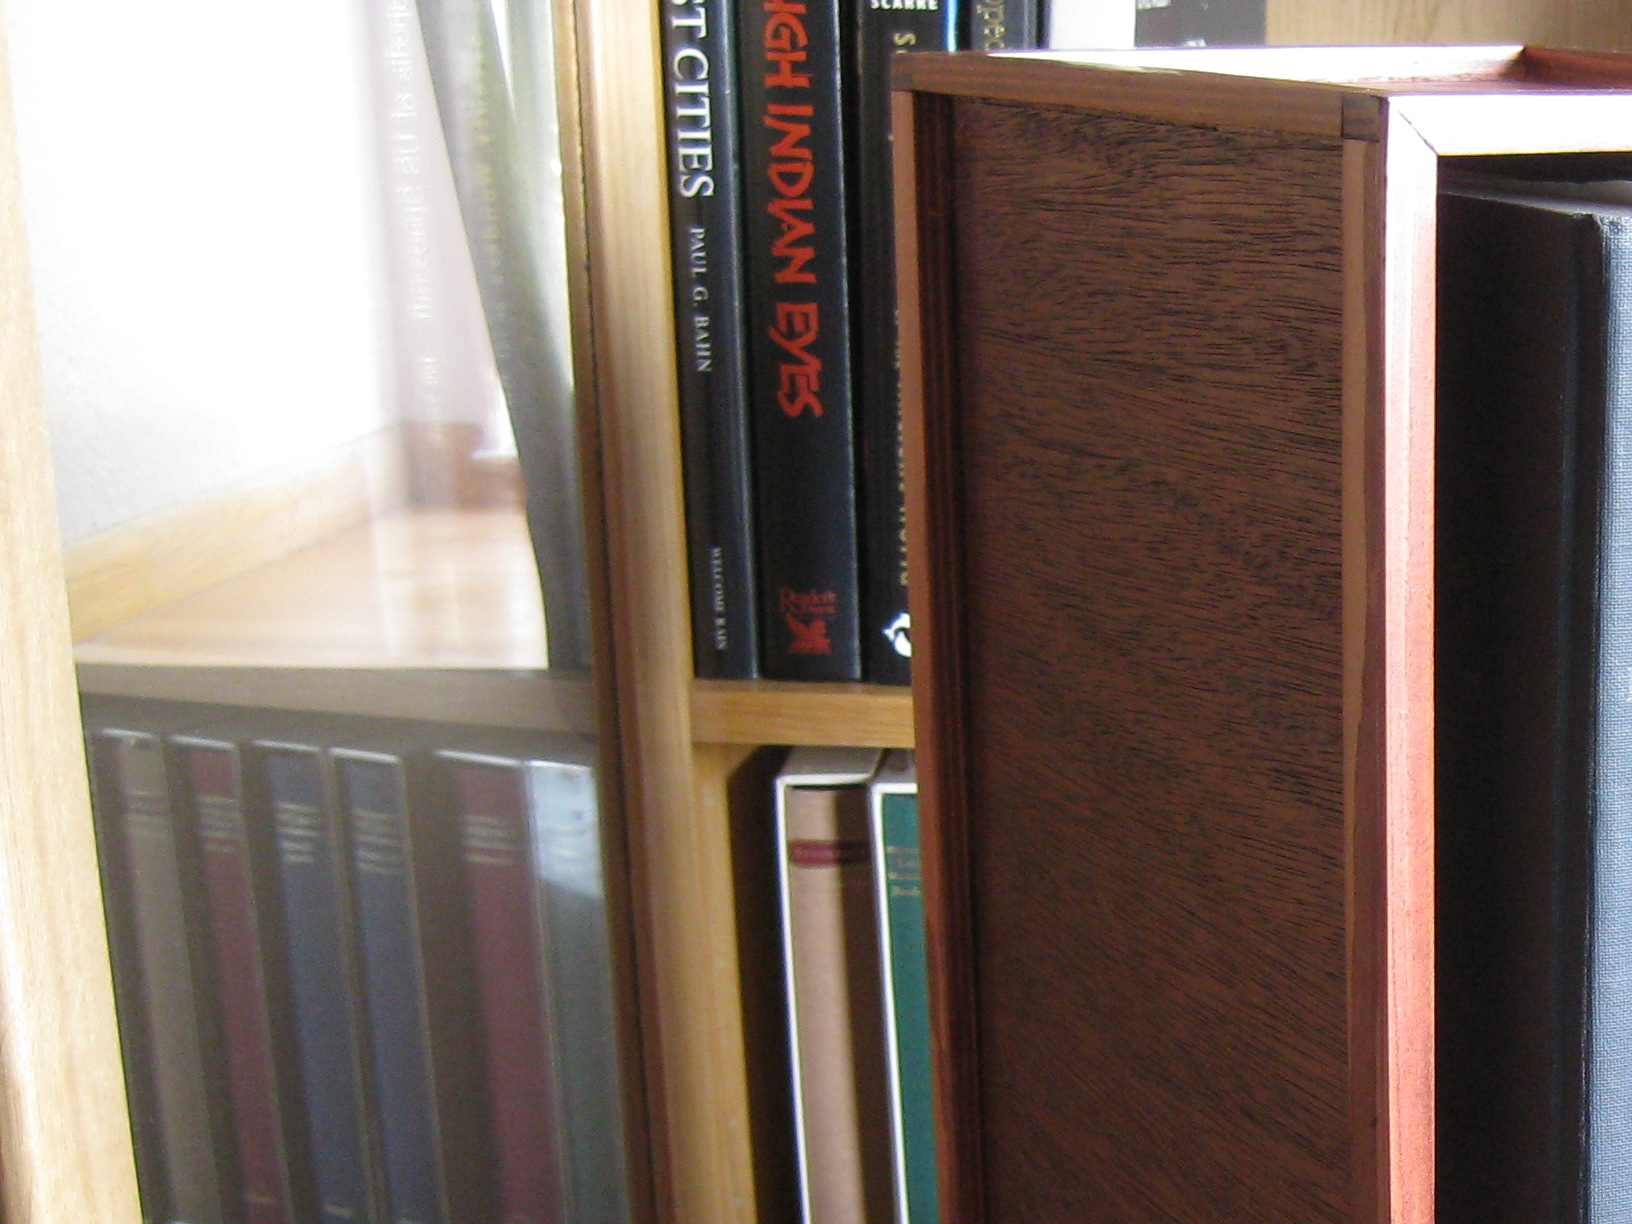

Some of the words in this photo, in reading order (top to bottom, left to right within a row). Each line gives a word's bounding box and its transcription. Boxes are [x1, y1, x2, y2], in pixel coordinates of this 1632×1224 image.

[671, 0, 707, 38] T
[673, 48, 715, 198] CITIES
[763, 104, 817, 283] INDIAN
[689, 226, 707, 278] PAUL
[768, 302, 825, 417] EYES
